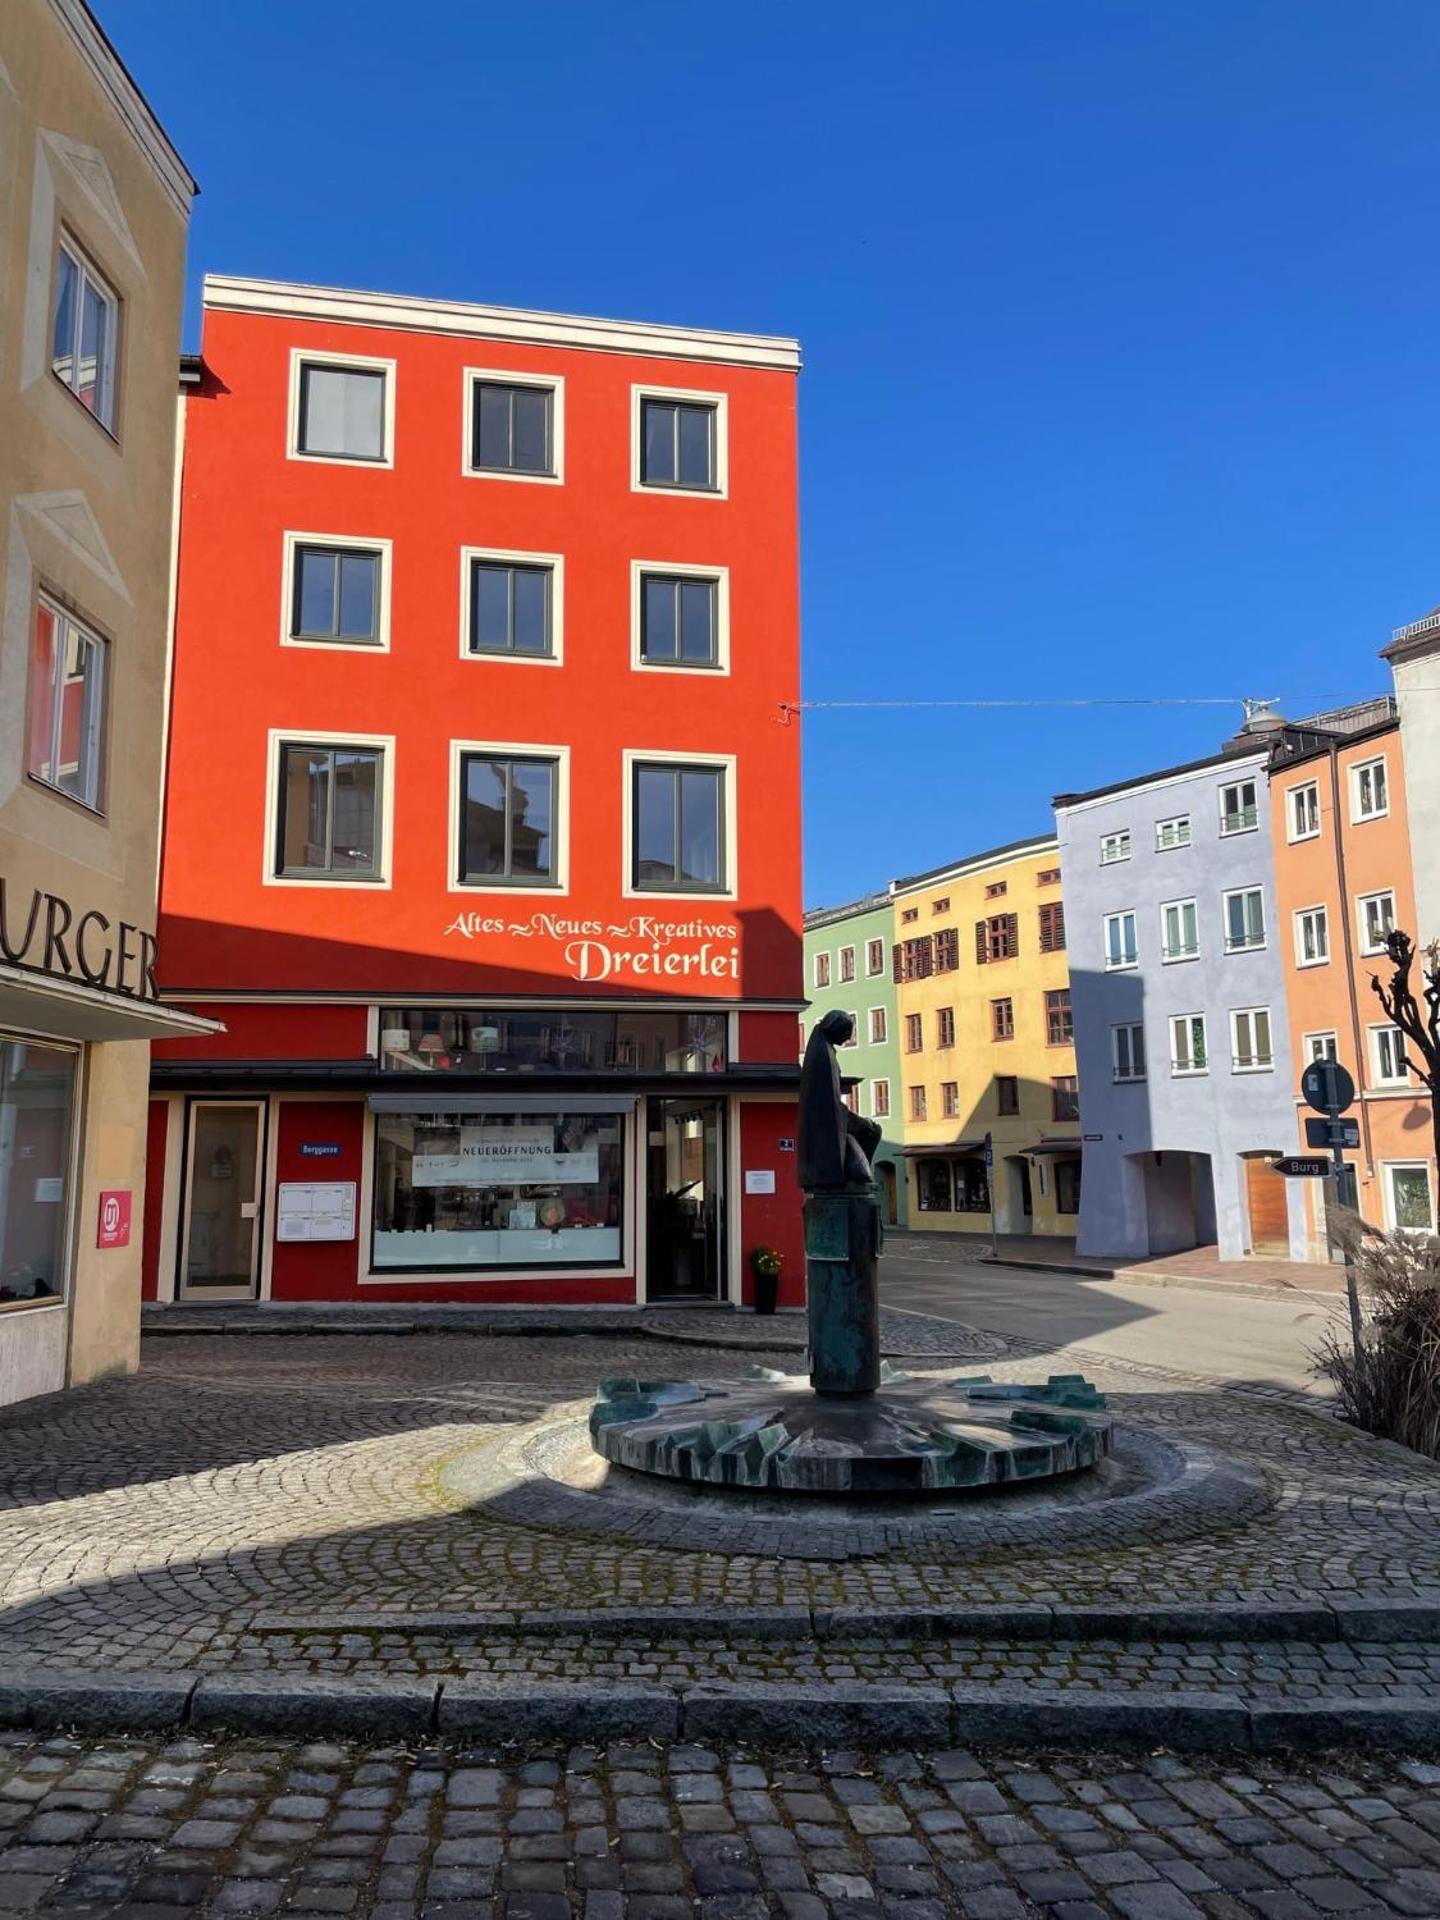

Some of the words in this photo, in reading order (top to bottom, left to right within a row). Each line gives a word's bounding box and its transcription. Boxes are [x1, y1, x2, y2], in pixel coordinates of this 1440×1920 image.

[443, 912, 504, 939] Altes
[531, 913, 602, 941] Neues
[629, 916, 737, 945] Kreatives
[564, 940, 741, 982] Dreierlei
[462, 1144, 552, 1156] NEUERÖFFNUNG
[1291, 1162, 1320, 1174] Burg
